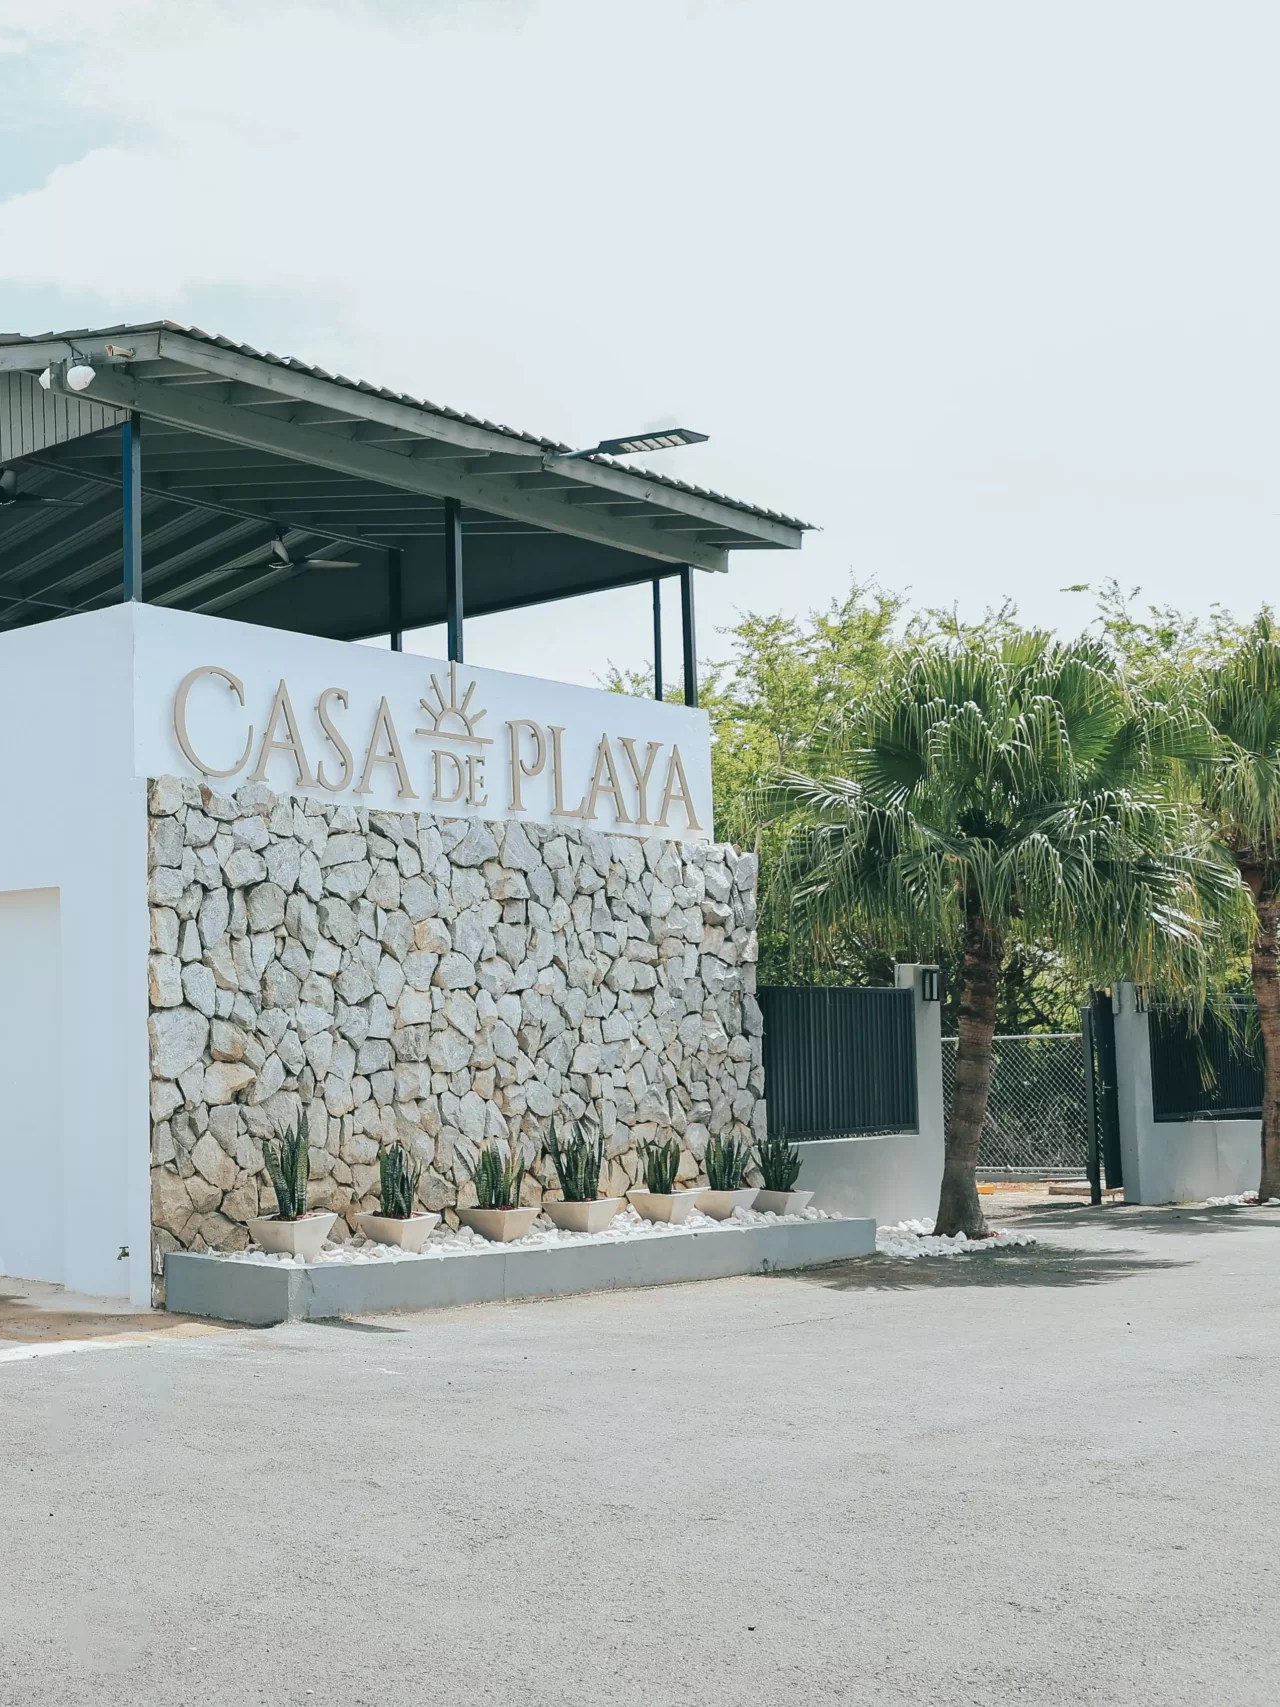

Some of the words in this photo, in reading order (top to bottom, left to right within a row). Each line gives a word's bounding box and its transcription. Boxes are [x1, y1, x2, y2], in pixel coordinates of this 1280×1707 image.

[174, 666, 419, 799] CASA
[432, 750, 488, 807] DE
[505, 719, 703, 830] PLAYA
